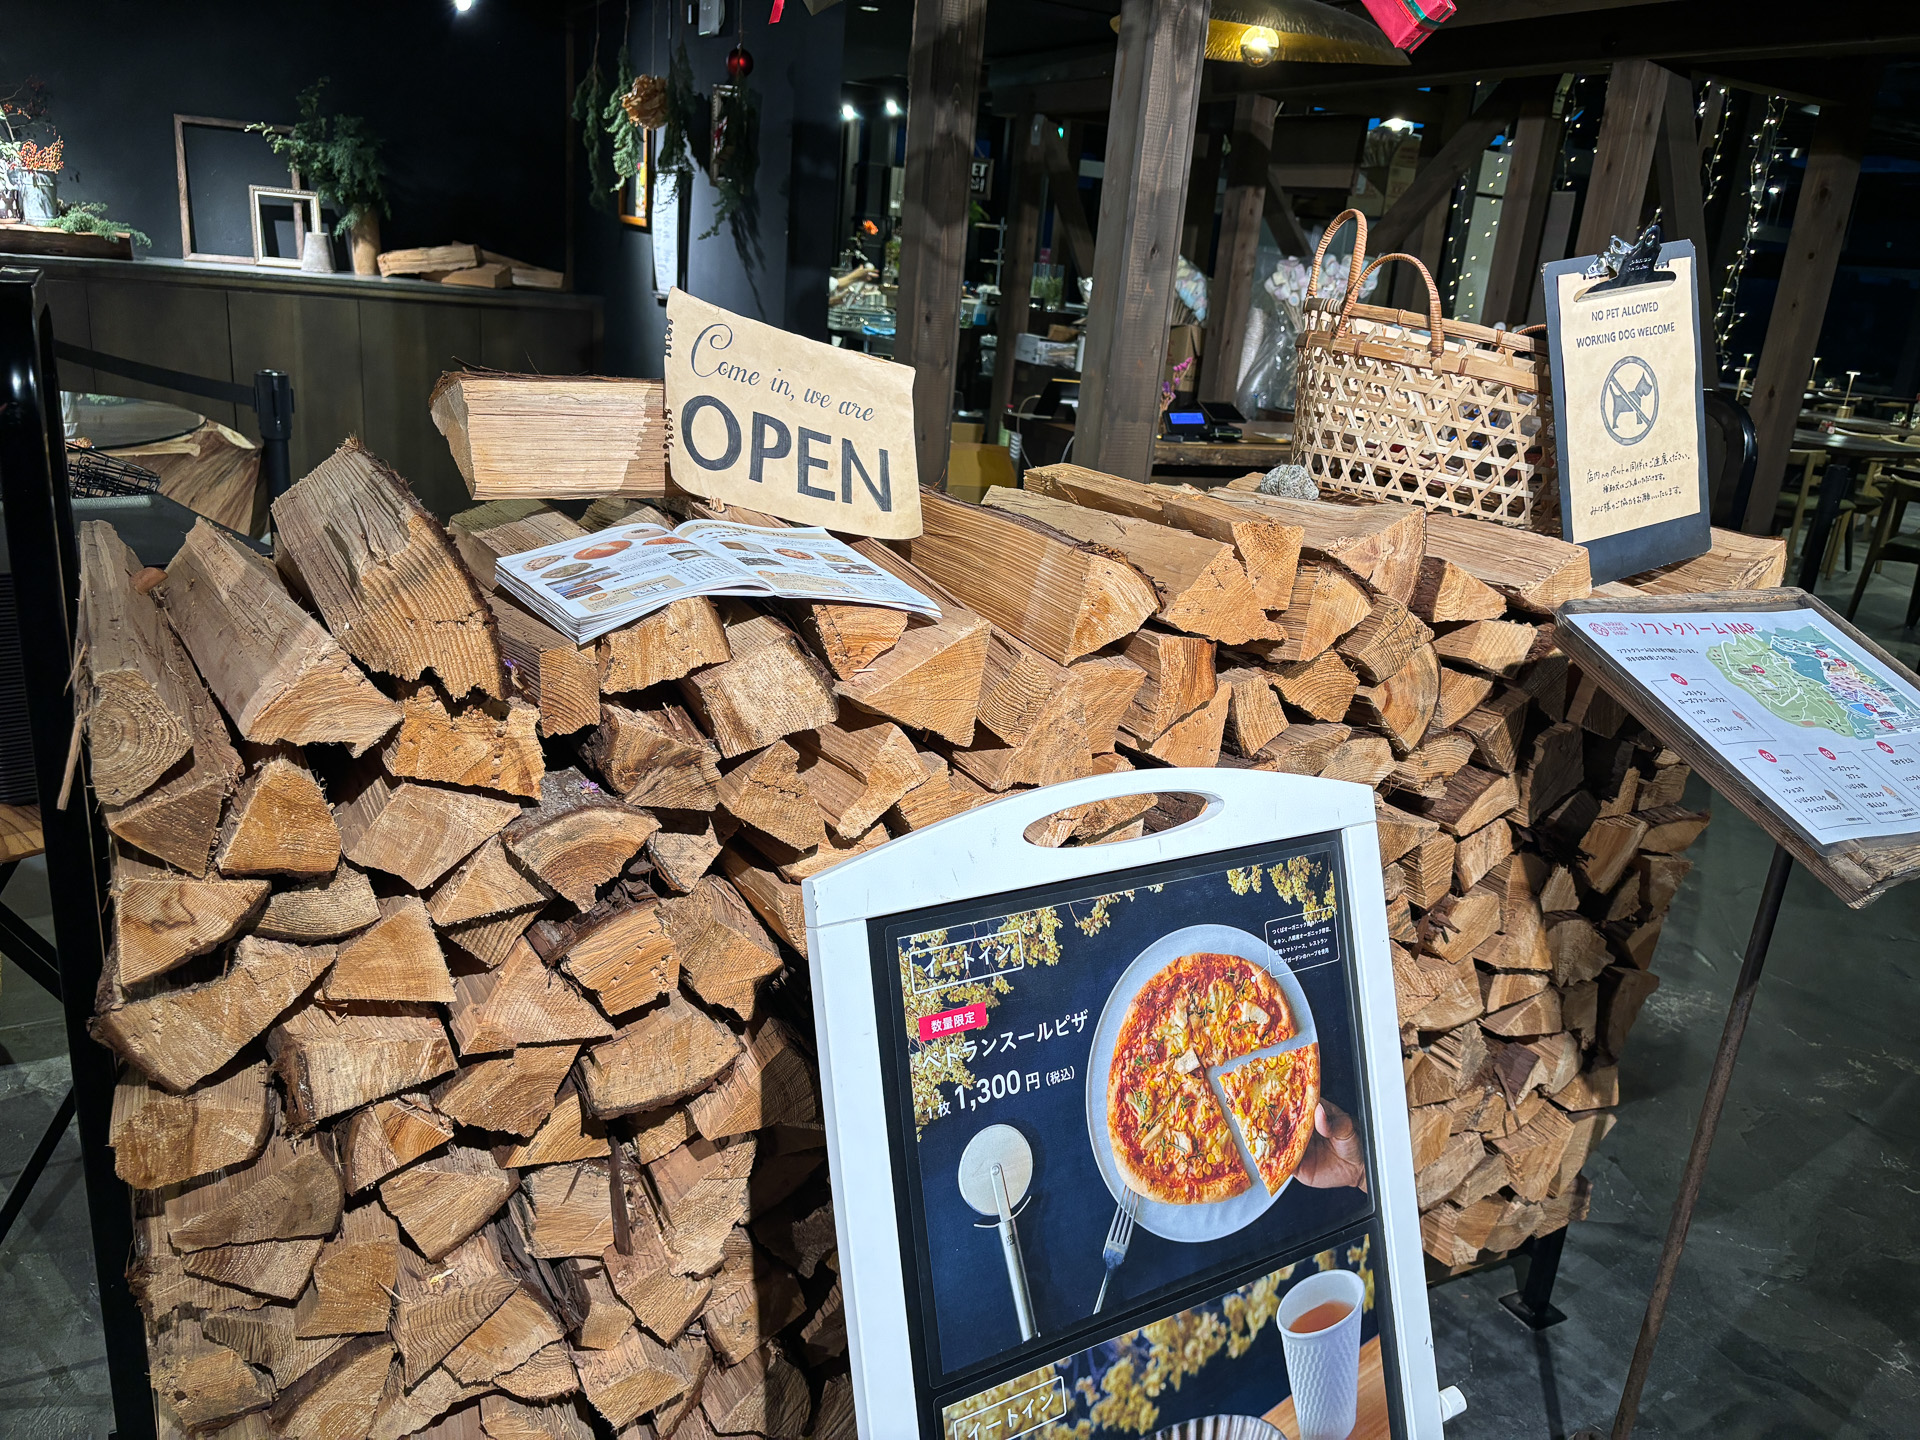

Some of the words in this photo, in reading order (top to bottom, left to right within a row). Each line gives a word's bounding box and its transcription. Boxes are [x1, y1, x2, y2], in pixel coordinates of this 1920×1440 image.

[1591, 310, 1604, 322] NO
[1606, 307, 1620, 320] PET
[1621, 301, 1659, 318] ALLOWED
[1576, 331, 1616, 348] WORKING
[1618, 328, 1636, 341] DOG
[1637, 321, 1676, 337] WELCOME
[690, 323, 761, 386] Come
[769, 368, 796, 401] in,
[803, 387, 833, 409] we
[838, 398, 875, 423] are
[681, 394, 893, 513] OPEN
[1630, 622, 1729, 636] ソフトクリーム
[1723, 622, 1756, 635] MAP
[923, 944, 1012, 979] イートイン
[922, 1008, 1089, 1069] ペトランスールピザ
[930, 1011, 976, 1034] 数量限定
[954, 1069, 1021, 1112] 1,300
[967, 1393, 1054, 1440] イートイン
